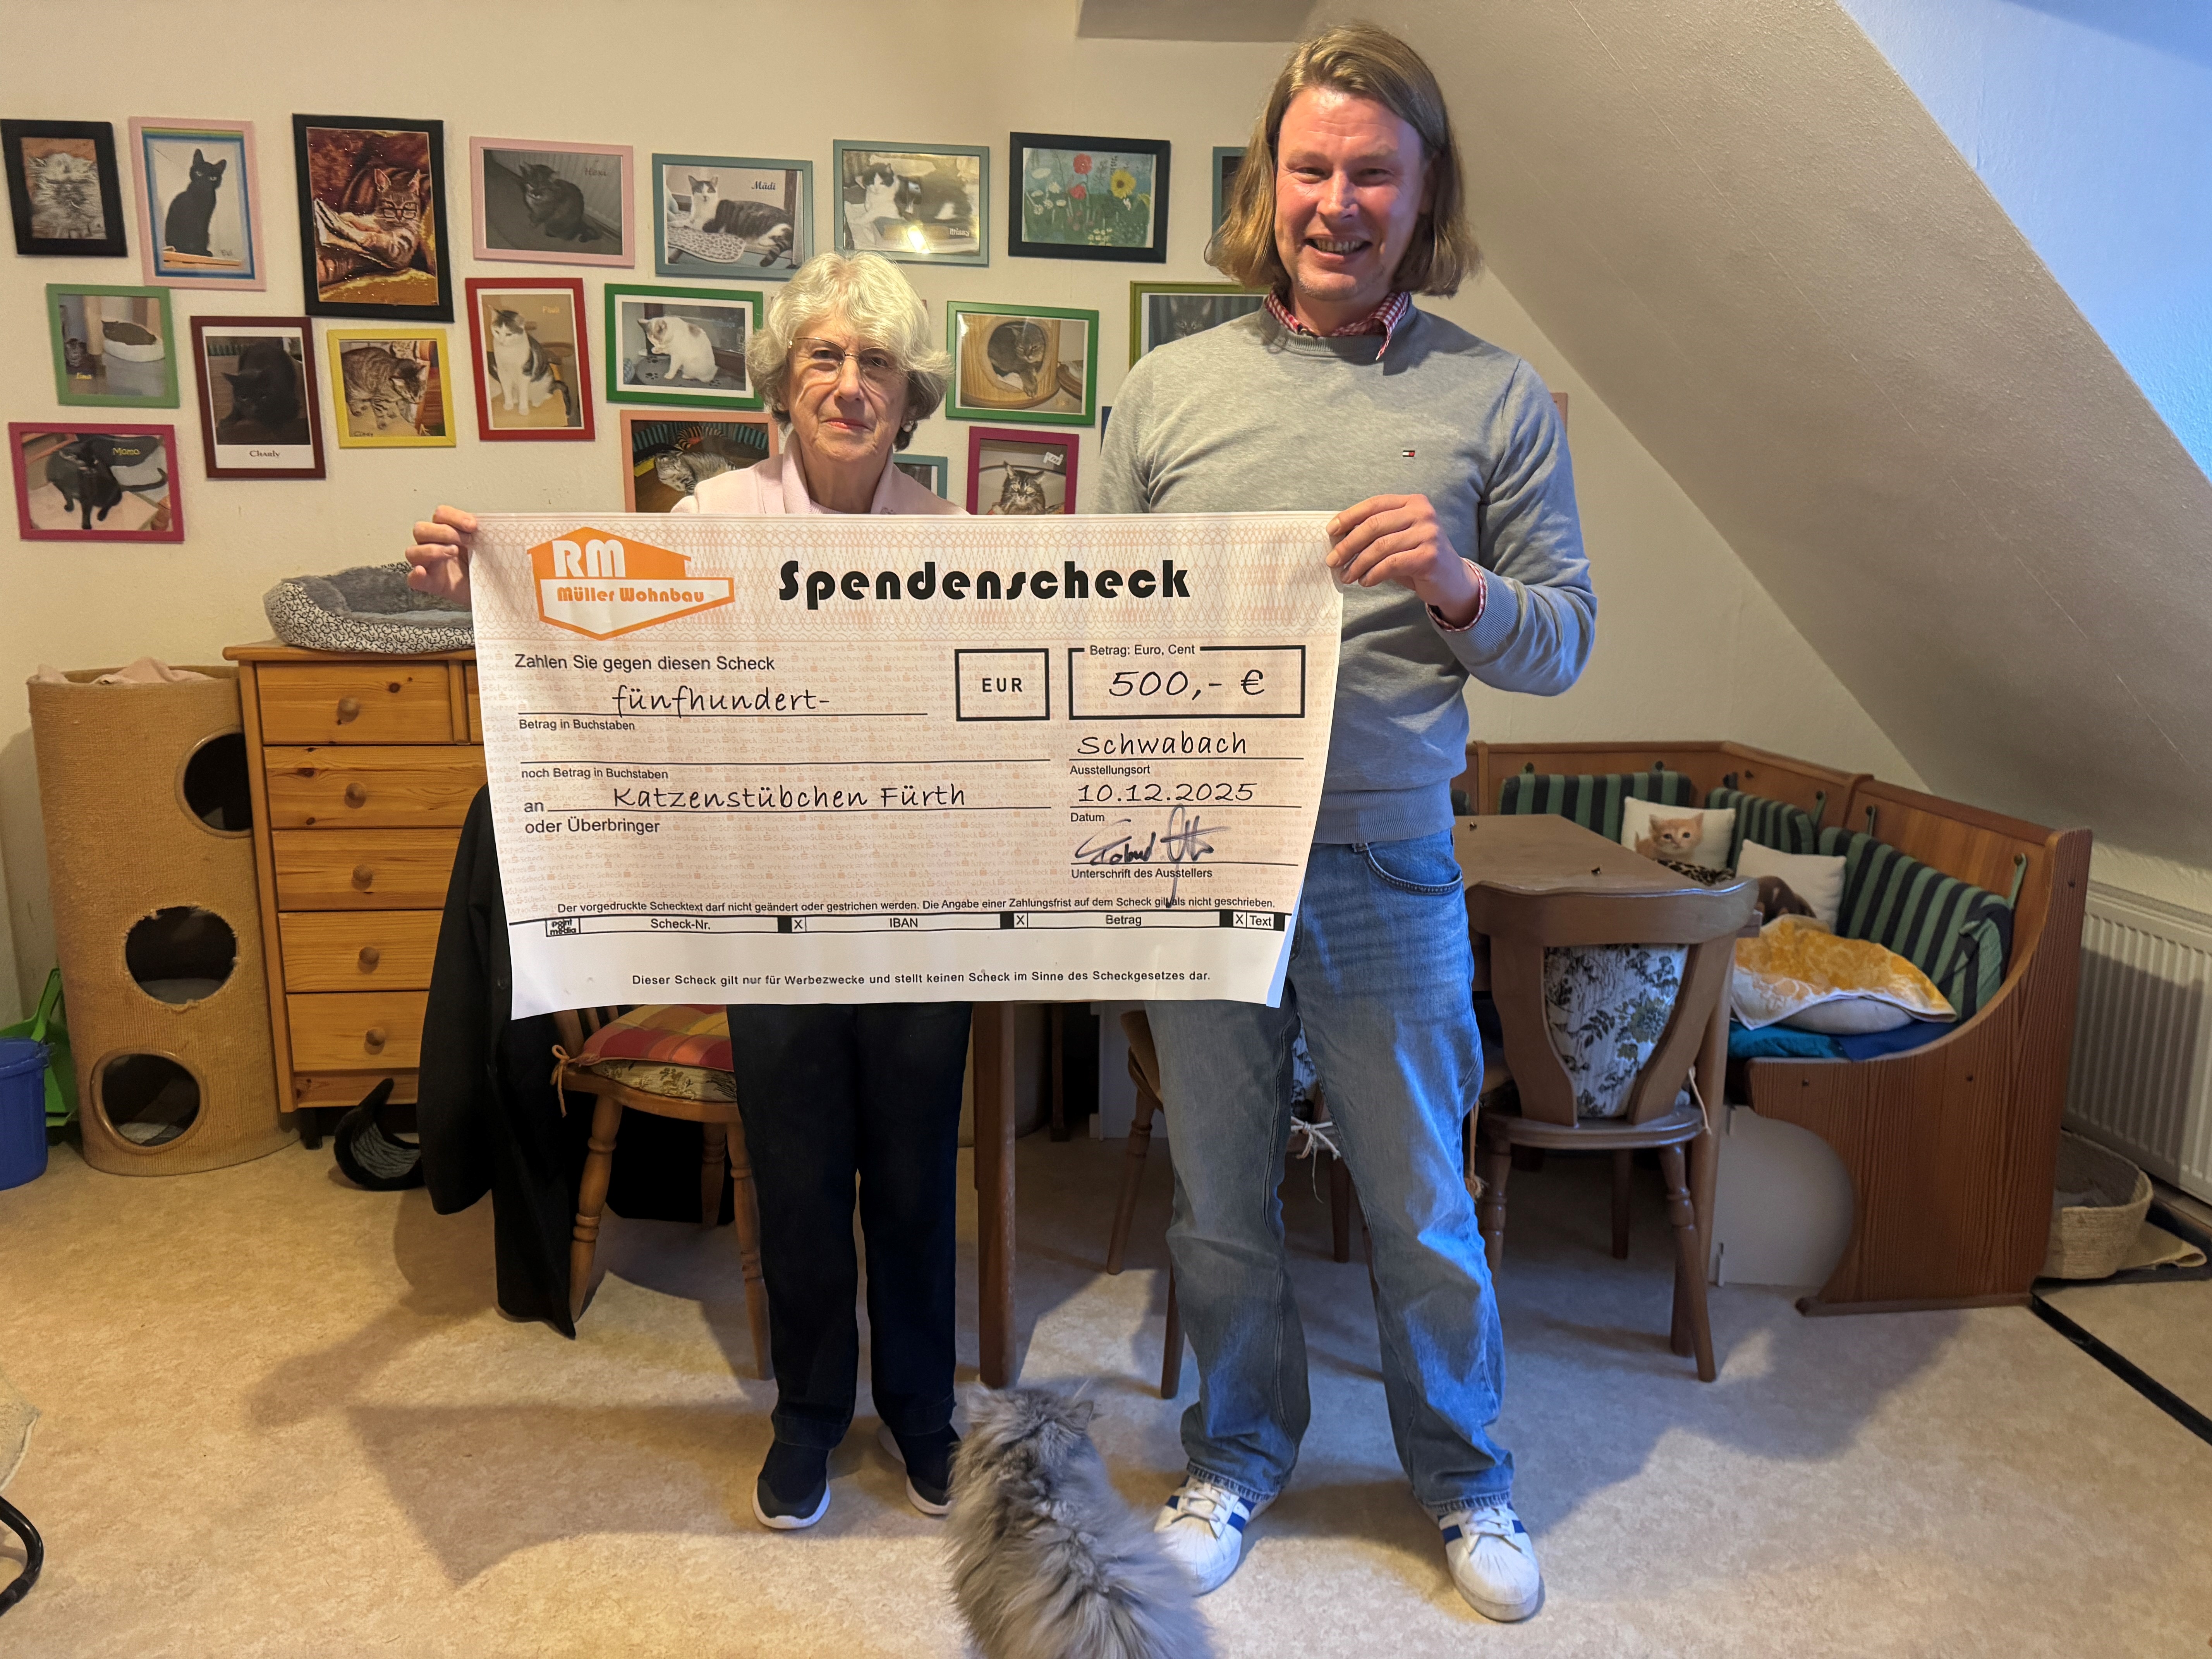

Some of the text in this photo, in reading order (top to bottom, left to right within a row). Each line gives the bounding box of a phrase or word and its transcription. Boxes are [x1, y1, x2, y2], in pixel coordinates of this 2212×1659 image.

[751, 180, 776, 191] Mädi
[949, 228, 970, 237] Missy
[112, 448, 140, 456] Momo
[249, 450, 280, 458] Charly
[552, 539, 626, 577] RM
[779, 560, 1190, 610] Spendenscheck
[557, 587, 704, 603] Müller Wohnbau
[1090, 644, 1195, 657] Betrag: Euro, Cent
[515, 654, 775, 673] Zahlen Sie gegen diesen Scheck
[982, 678, 1022, 692] EUR
[1109, 669, 1265, 701] 500,- €
[611, 685, 830, 718] fünfhundert-
[519, 719, 556, 731] Betrag
[573, 719, 635, 730] Buchstaben
[1077, 730, 1246, 755] Schwabach
[522, 768, 668, 779] noch Betrag in Buchstaben
[1070, 764, 1150, 777] Ausstellungsort
[614, 783, 964, 809] Katzenstübchen Fürth
[1078, 783, 1257, 802] 10.12.2025
[524, 802, 543, 812] an
[1071, 812, 1104, 822] Datum
[525, 816, 660, 835] oder Überbringer
[1072, 868, 1212, 879] Unterschrift des Ausstellers
[558, 904, 577, 913] Der
[580, 901, 647, 913] vorgedruckte
[650, 901, 703, 912] Schecktext
[705, 902, 725, 912] darf
[728, 902, 752, 911] nicht
[755, 902, 798, 913] geändert
[801, 902, 824, 911] oder
[826, 902, 878, 913] gestrichen
[880, 900, 919, 910] werden.
[923, 900, 939, 909] Die
[941, 899, 979, 910] Angabe
[982, 900, 1006, 908] einer
[1009, 898, 1072, 909] Zahlungsfrist
[1074, 897, 1090, 907] auf
[1092, 897, 1113, 907] dem
[1116, 897, 1152, 907] Scheck
[1188, 897, 1211, 906] nicht
[1214, 897, 1275, 908] geschrieben.
[651, 914, 1271, 930] Scheck-Nr. X IBAN X Betrag X Text
[632, 975, 670, 984] Dieser
[675, 975, 716, 985] Scheck
[720, 975, 738, 987] gilt
[765, 975, 781, 984] für
[784, 975, 864, 985] Werbezwecke
[869, 974, 890, 984] und
[895, 974, 922, 983] stellt
[927, 973, 964, 983] keinen
[969, 972, 1010, 982] Scheck
[1014, 972, 1027, 981] im
[1032, 971, 1063, 981] Sinne
[1068, 971, 1088, 981] des
[1092, 971, 1185, 982] Scheckgesetzes
[1189, 971, 1210, 980] dar.
